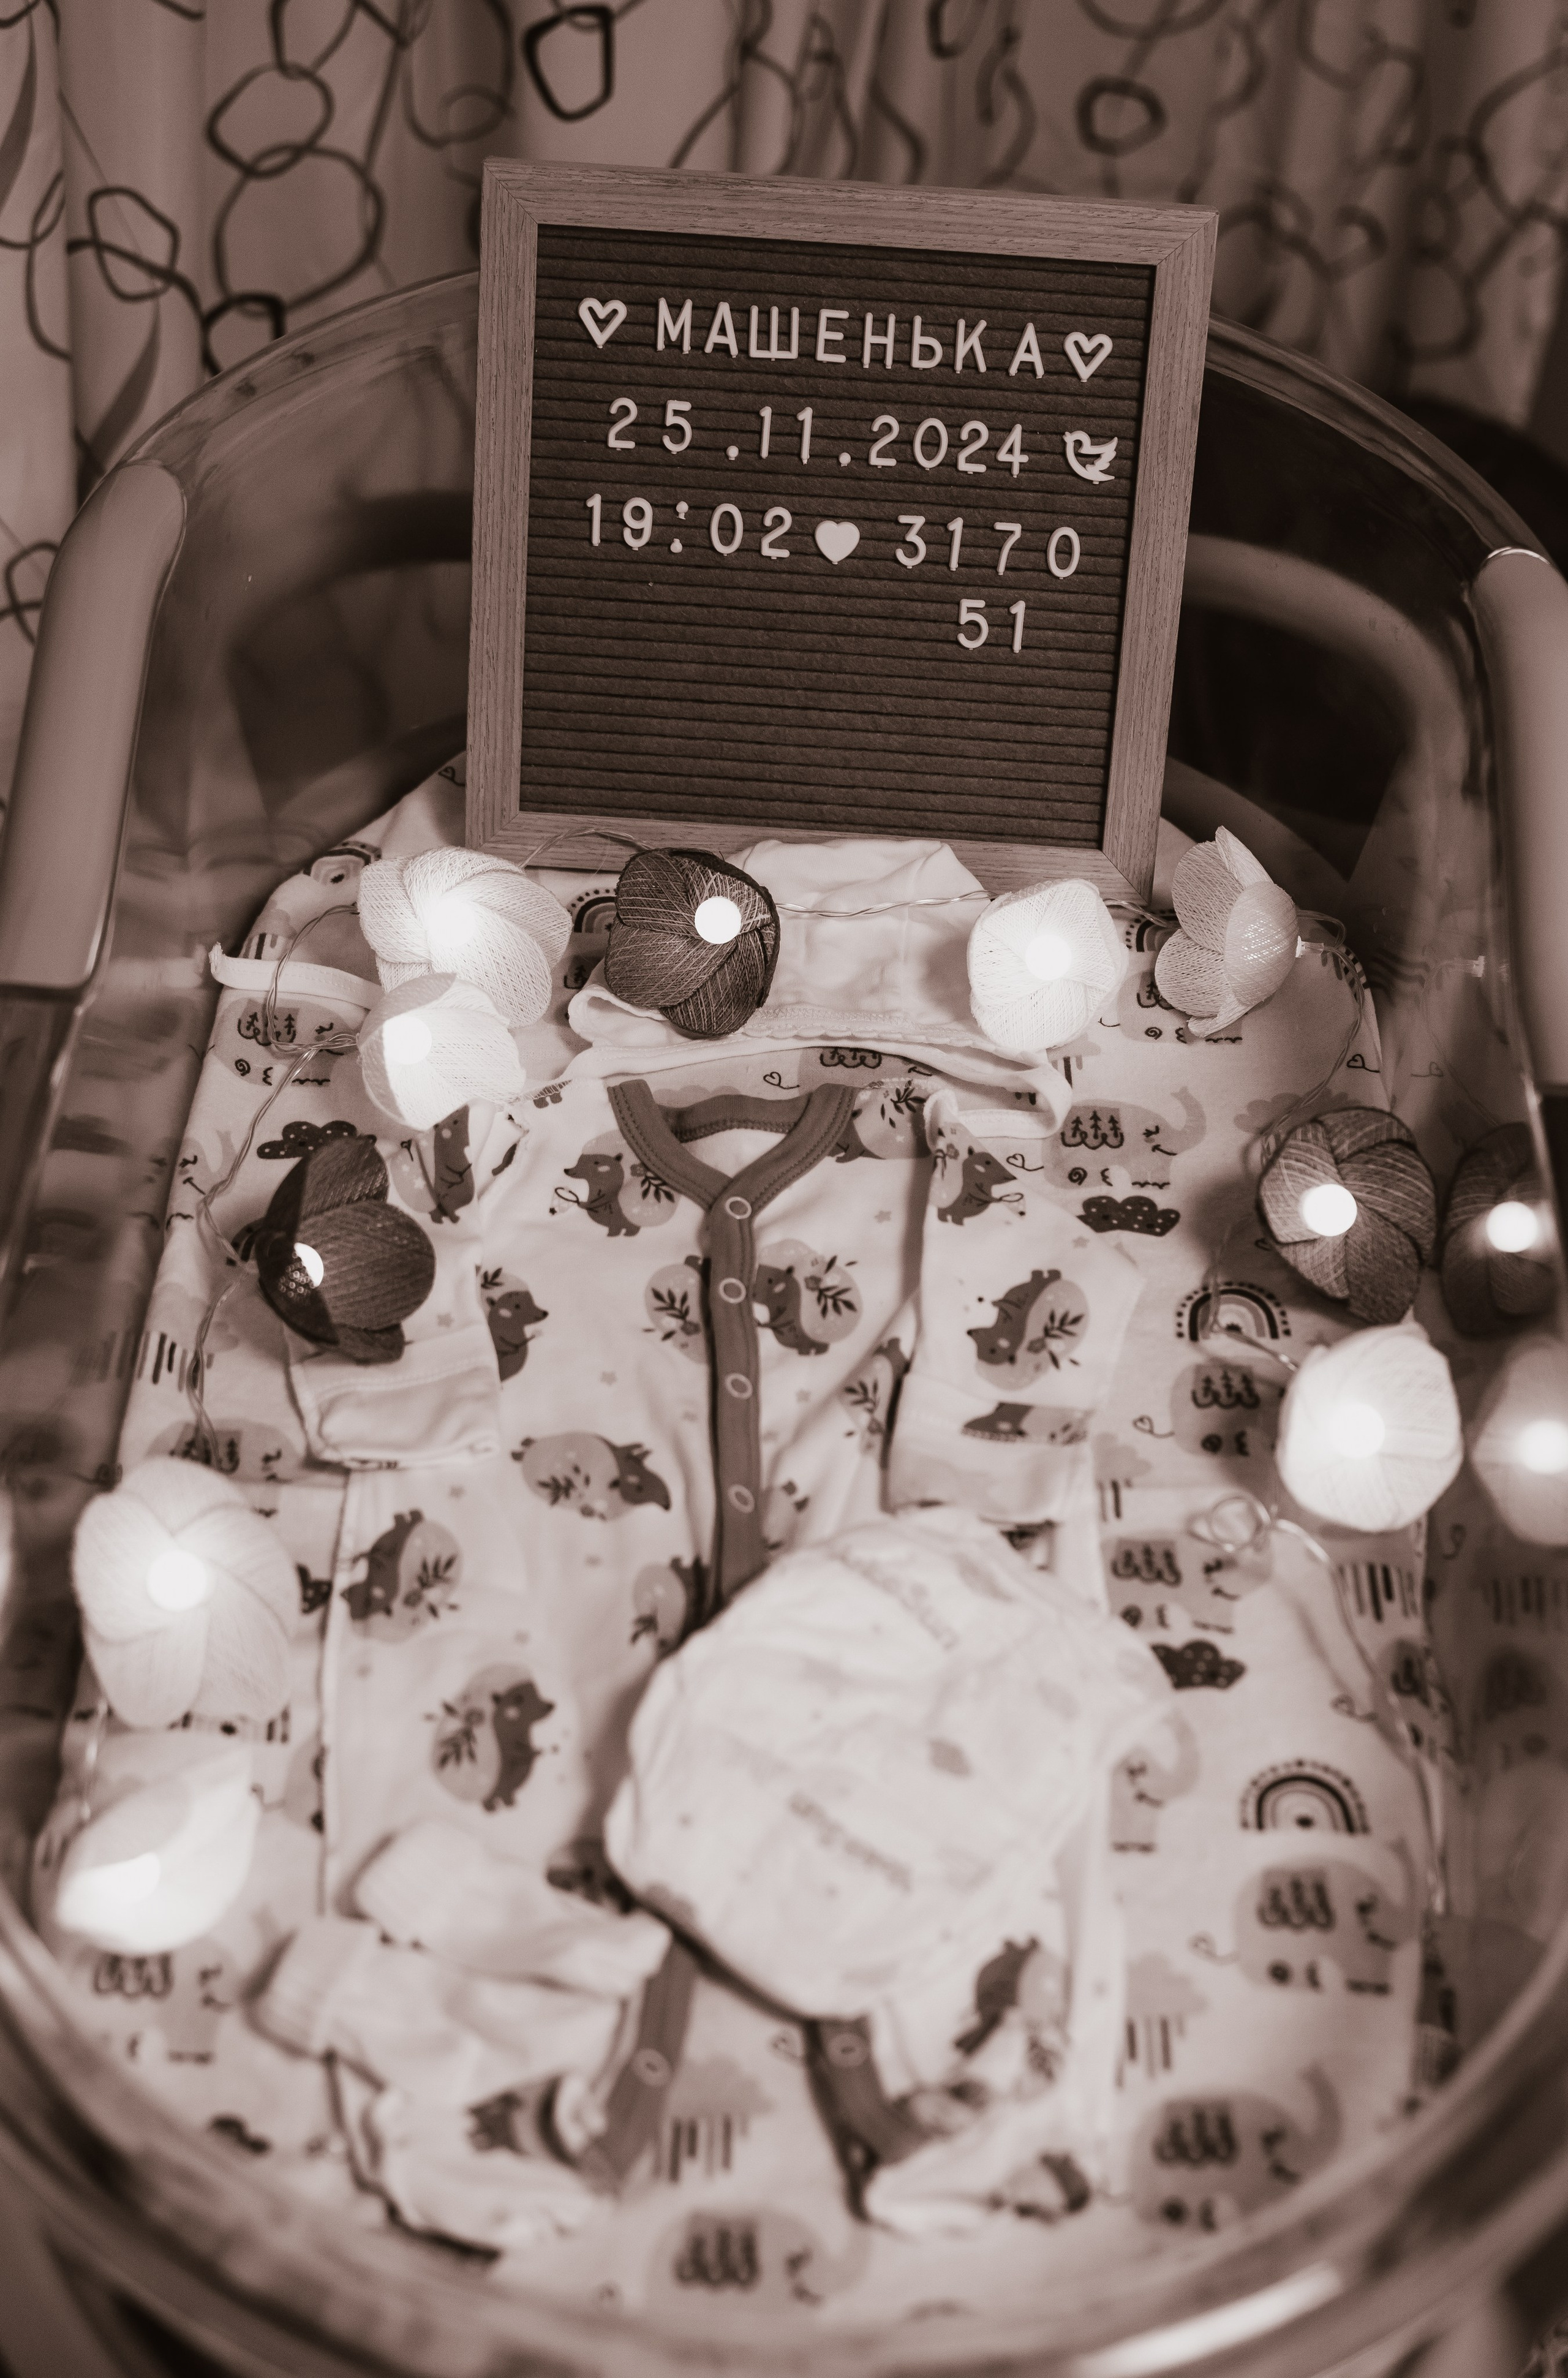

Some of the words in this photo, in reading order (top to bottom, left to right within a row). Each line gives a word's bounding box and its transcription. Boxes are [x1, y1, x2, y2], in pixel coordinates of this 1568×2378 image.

[657, 297, 1044, 379] МАШЕНЬКА
[586, 493, 793, 560] 19:02
[895, 515, 1081, 578] 3170
[957, 598, 1026, 653] 51
